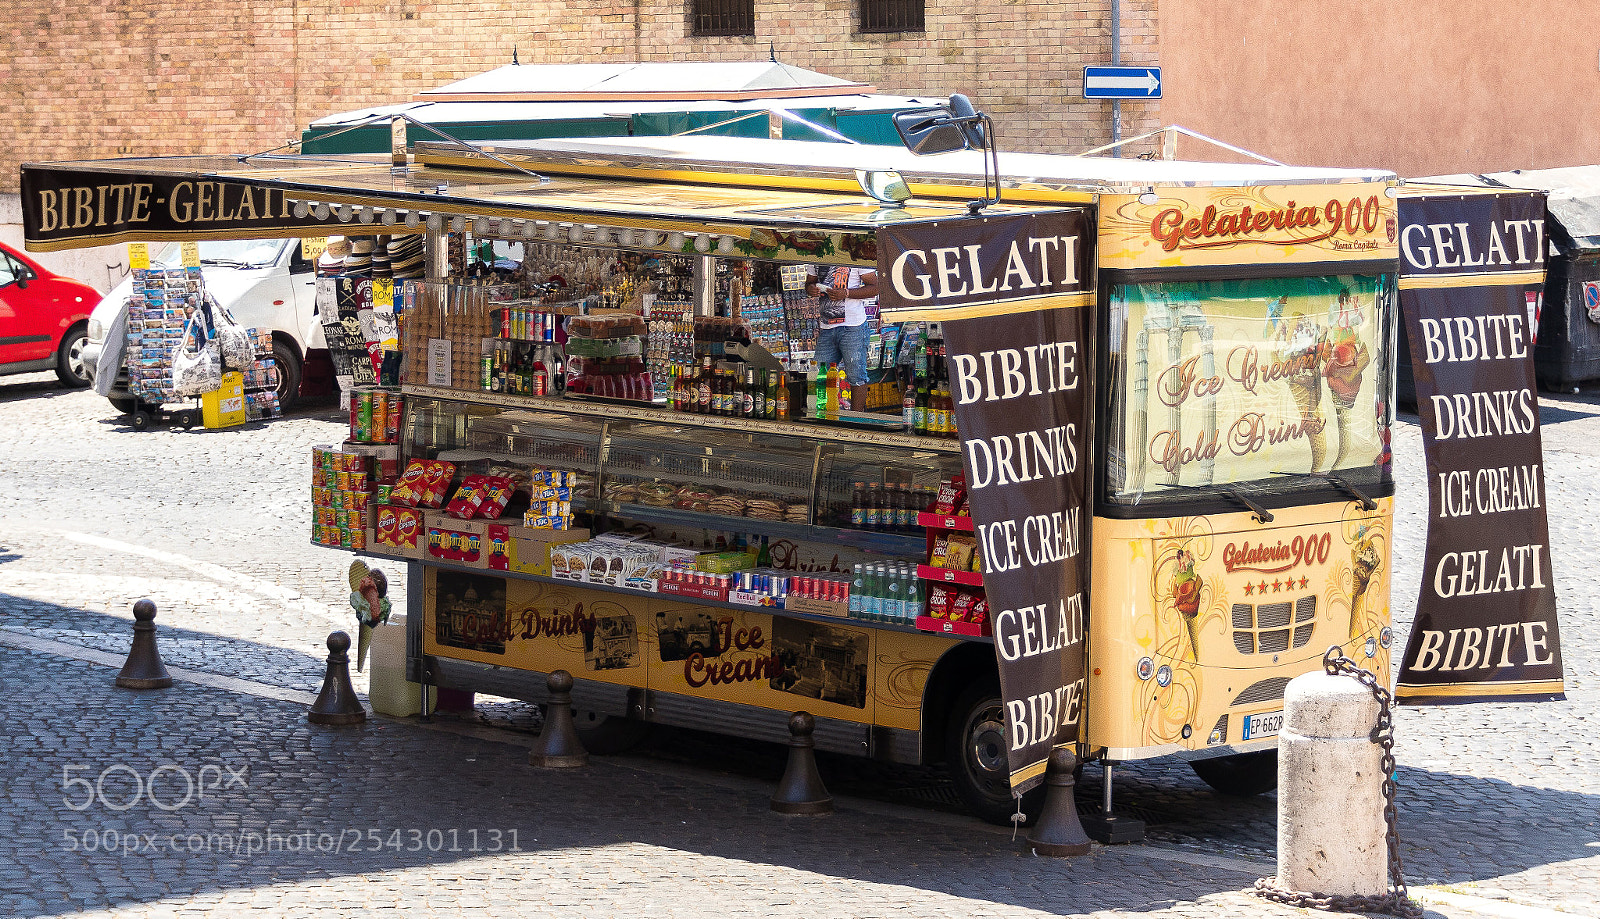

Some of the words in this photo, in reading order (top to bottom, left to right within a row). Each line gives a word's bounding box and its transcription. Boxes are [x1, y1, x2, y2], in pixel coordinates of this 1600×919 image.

[1150, 200, 1320, 252] Gelateria
[1324, 194, 1380, 237] 900
[1401, 219, 1545, 269] GELATI
[891, 236, 1079, 300] GELATI
[1420, 314, 1527, 363] BIBITE
[953, 341, 1078, 405] BIBITE
[1157, 355, 1226, 407] Ice
[1431, 389, 1535, 440] DRINKS
[966, 423, 1077, 489] DRINKS
[1149, 430, 1221, 474] Cold
[542, 489, 555, 498] TUC
[1439, 470, 1472, 517] ICE
[1475, 464, 1540, 514] CREAM
[536, 517, 548, 526] TUC
[978, 519, 1021, 574] ICE
[1023, 506, 1080, 567] CREAM
[1222, 540, 1290, 569] Gelateria
[1291, 532, 1332, 566] 900
[1434, 545, 1545, 598] GELATI
[463, 609, 515, 644] Cold
[521, 602, 597, 640] Drinks
[715, 616, 764, 653] Ice
[996, 592, 1083, 661] GELATI
[1409, 620, 1553, 672] BIBITE
[684, 652, 785, 688] Cream
[1007, 678, 1085, 751] BIBITE
[1251, 719, 1261, 735] EP
